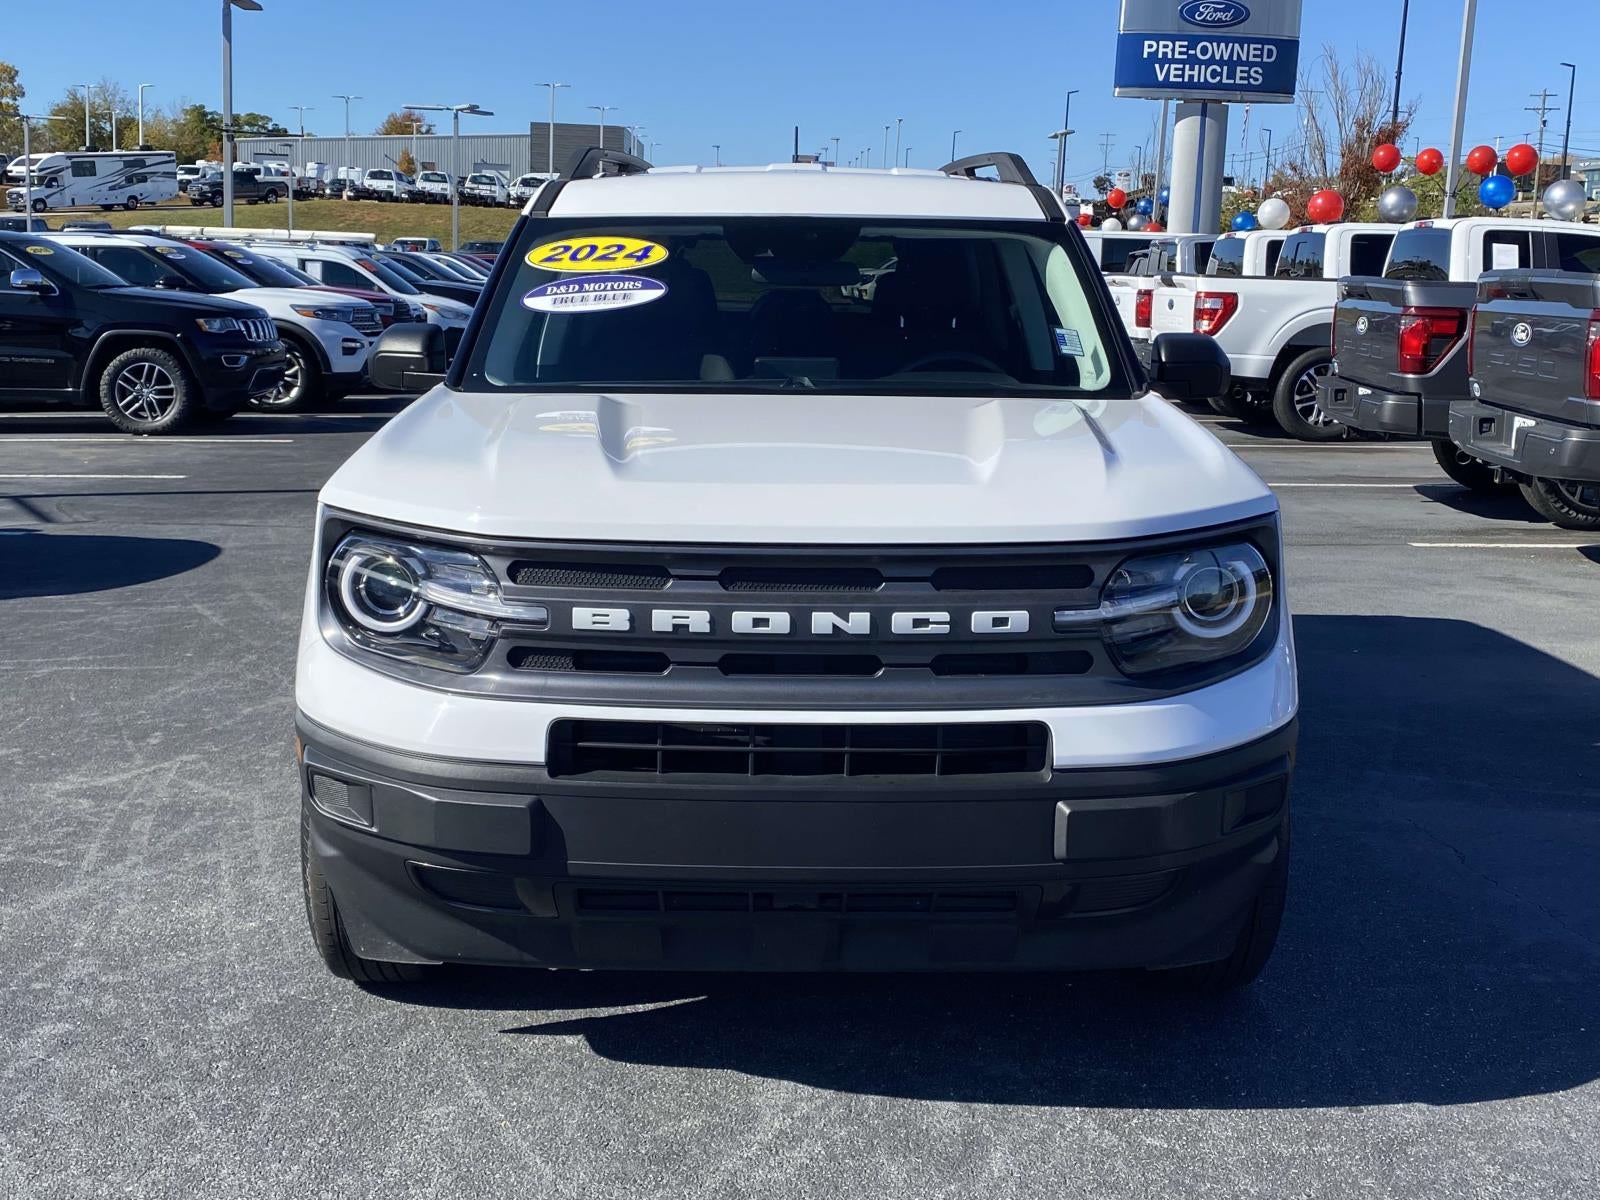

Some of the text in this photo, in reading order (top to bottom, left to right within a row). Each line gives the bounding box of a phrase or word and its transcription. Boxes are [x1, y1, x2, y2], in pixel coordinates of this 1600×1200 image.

[1195, 3, 1235, 21] Ford
[1143, 40, 1278, 63] PRE-OWNED
[1154, 63, 1264, 85] VEHICLES
[539, 243, 657, 264] 2024
[546, 280, 643, 296] D&D MOTORS
[552, 293, 590, 306] TRUE
[593, 291, 633, 303] BLUE
[572, 607, 1030, 635] BRONCO
